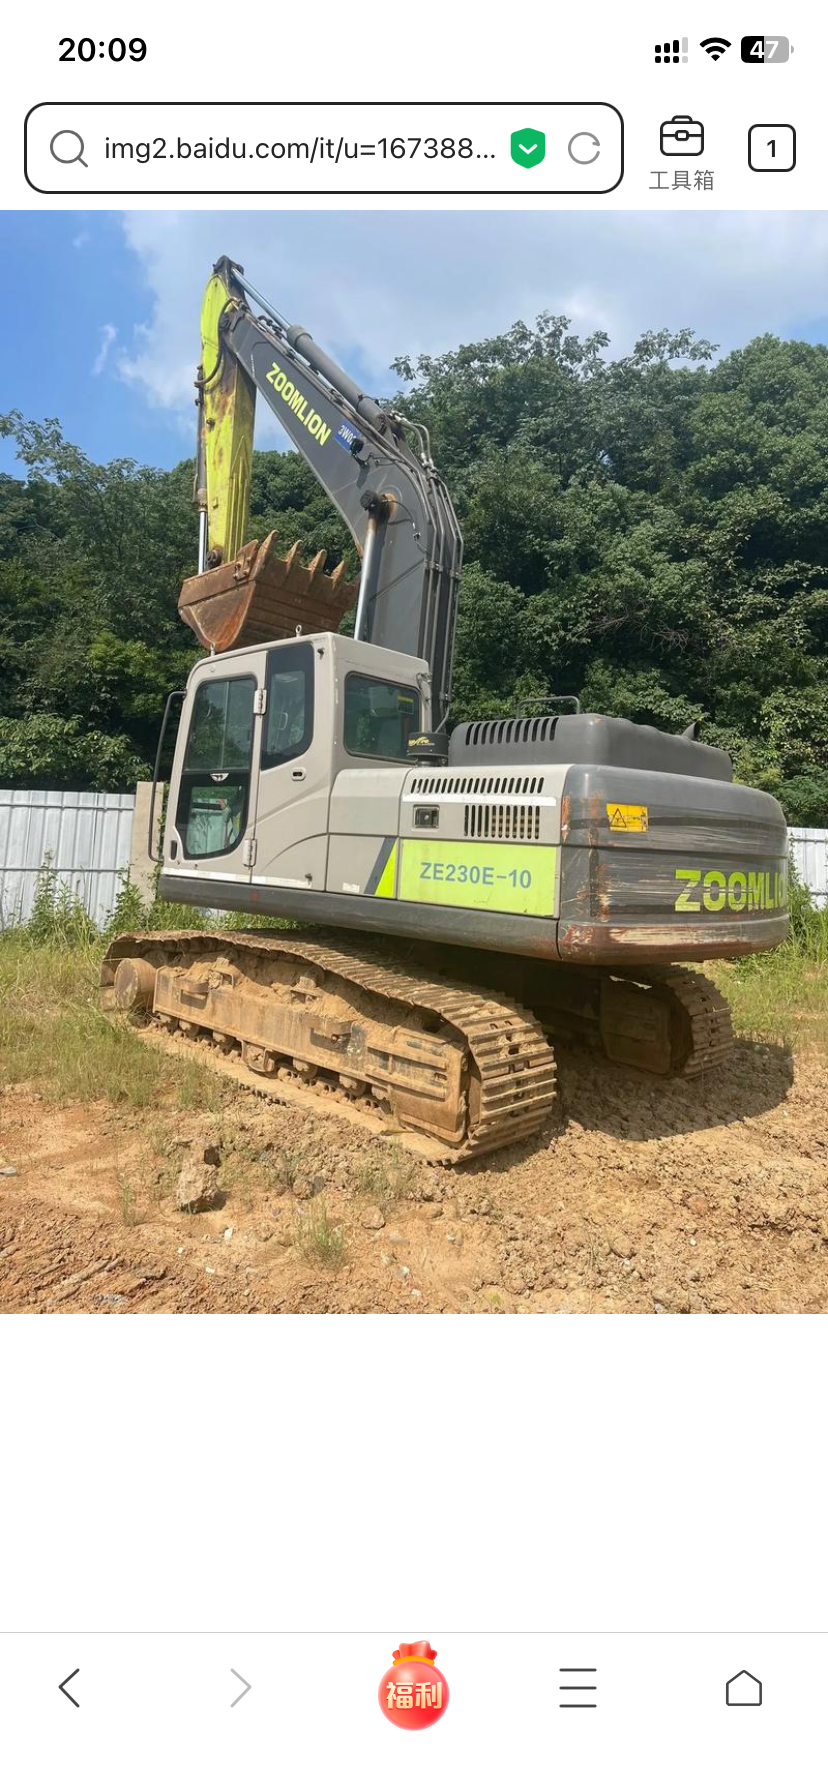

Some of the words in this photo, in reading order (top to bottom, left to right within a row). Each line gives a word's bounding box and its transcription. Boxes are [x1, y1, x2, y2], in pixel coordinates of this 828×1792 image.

[58, 38, 148, 62] 20:09
[750, 41, 779, 59] 47
[105, 136, 496, 164] img2.baidu.com/it/u=167388...
[766, 140, 776, 157] 1
[648, 170, 715, 191] 工具箱
[265, 362, 332, 447] ZOOMLION
[420, 862, 532, 889] ZE230E-10
[386, 1681, 443, 1710] 福利
